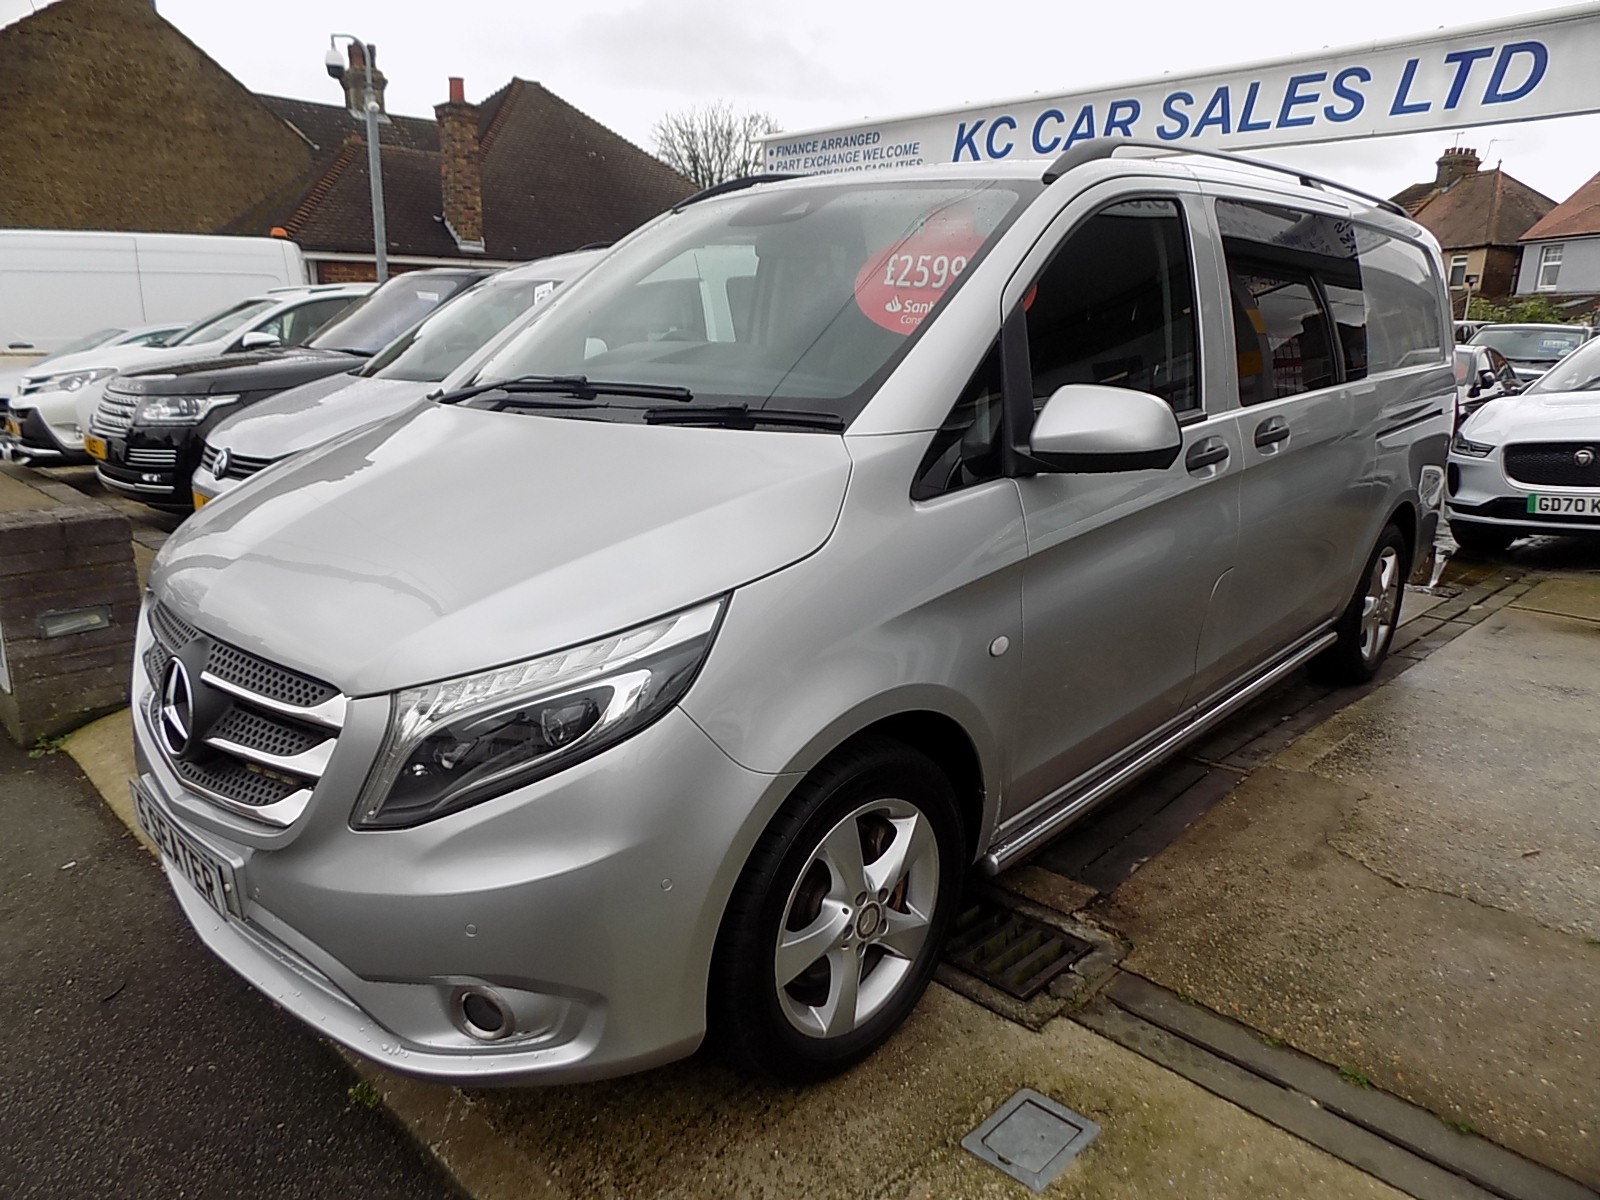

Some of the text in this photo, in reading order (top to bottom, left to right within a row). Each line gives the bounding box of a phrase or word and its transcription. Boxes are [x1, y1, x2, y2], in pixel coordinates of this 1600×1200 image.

[951, 40, 1549, 163] KC CAR SALES LTD
[776, 131, 881, 157] FINANCE ARRANGED
[776, 142, 920, 172] PART EXCHANGE WELCOME
[1539, 497, 1586, 512] GD70
